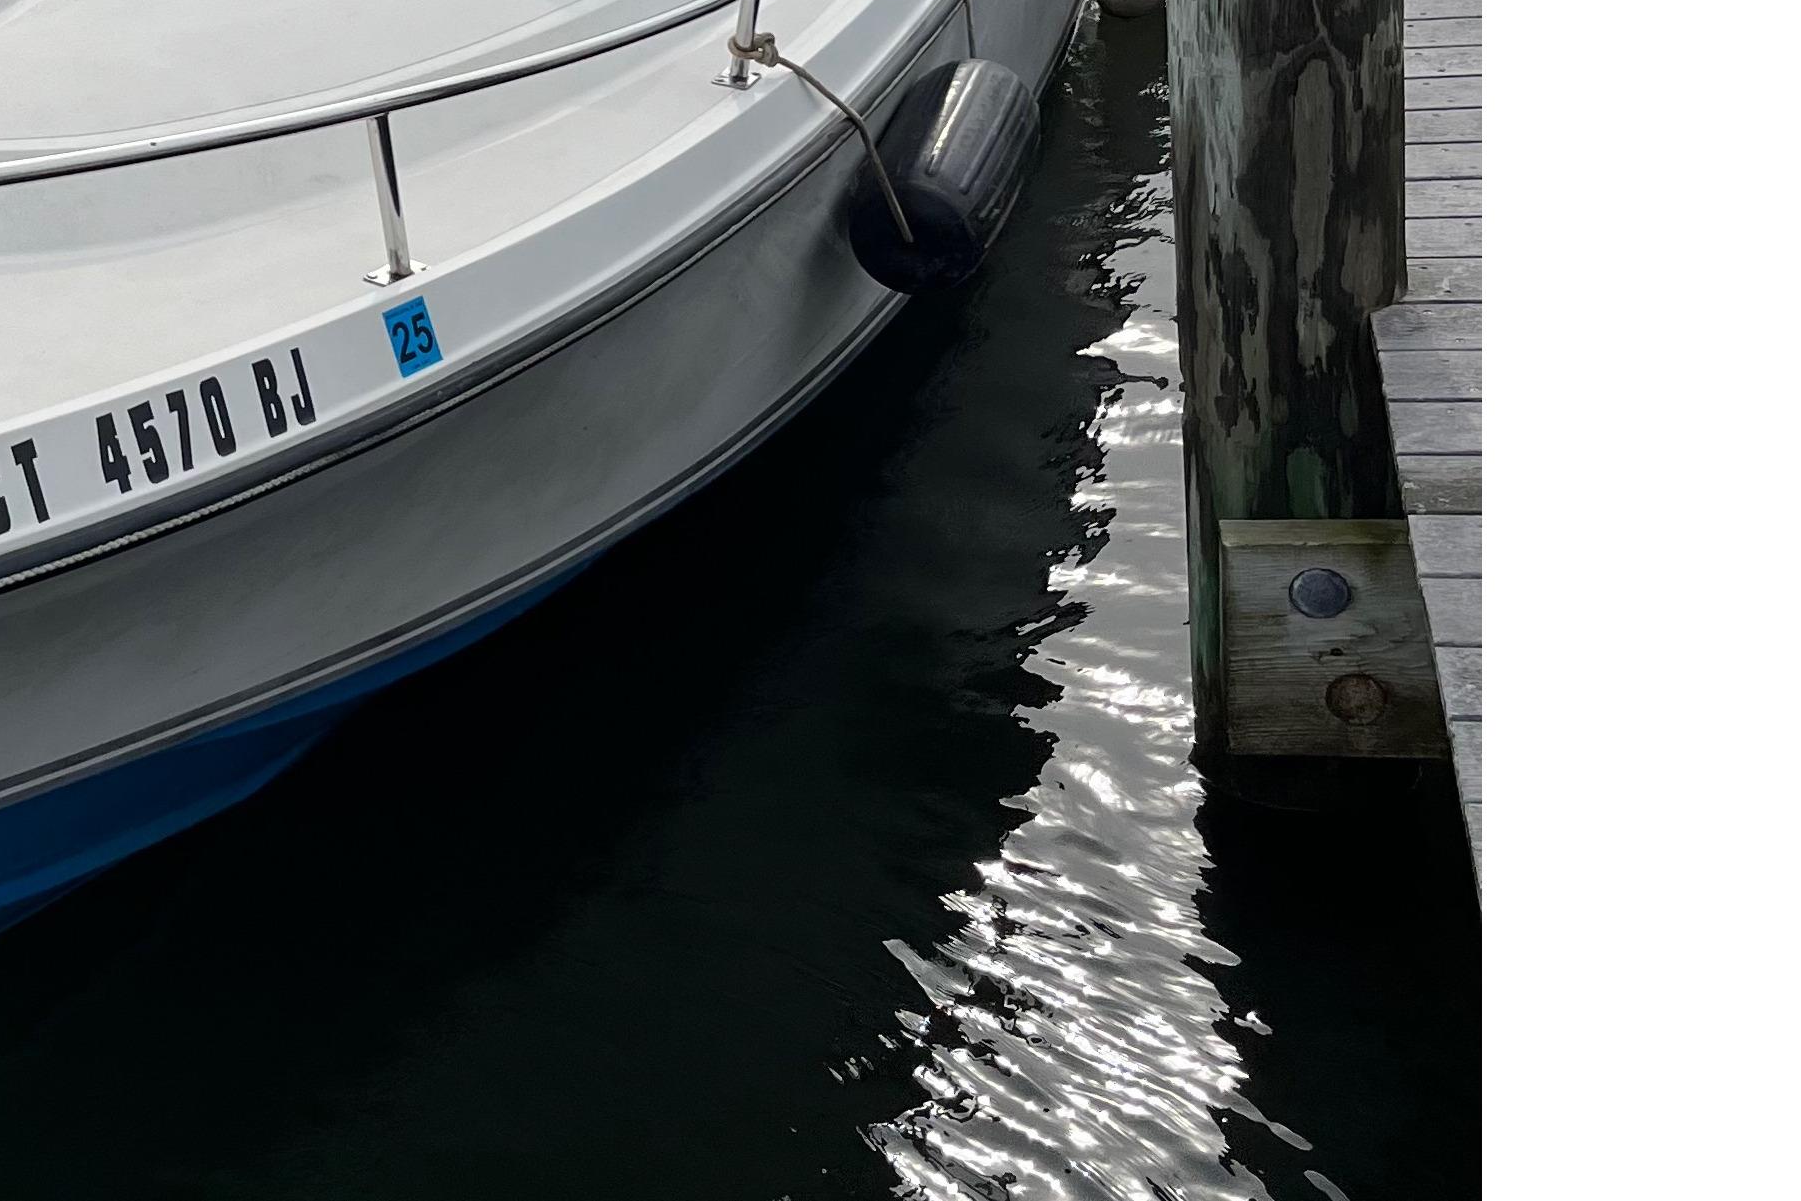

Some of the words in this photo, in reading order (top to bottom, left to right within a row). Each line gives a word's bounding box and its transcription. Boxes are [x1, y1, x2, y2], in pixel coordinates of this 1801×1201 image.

[392, 312, 434, 364] 25
[96, 376, 237, 493] 4570
[251, 348, 316, 438] BJ
